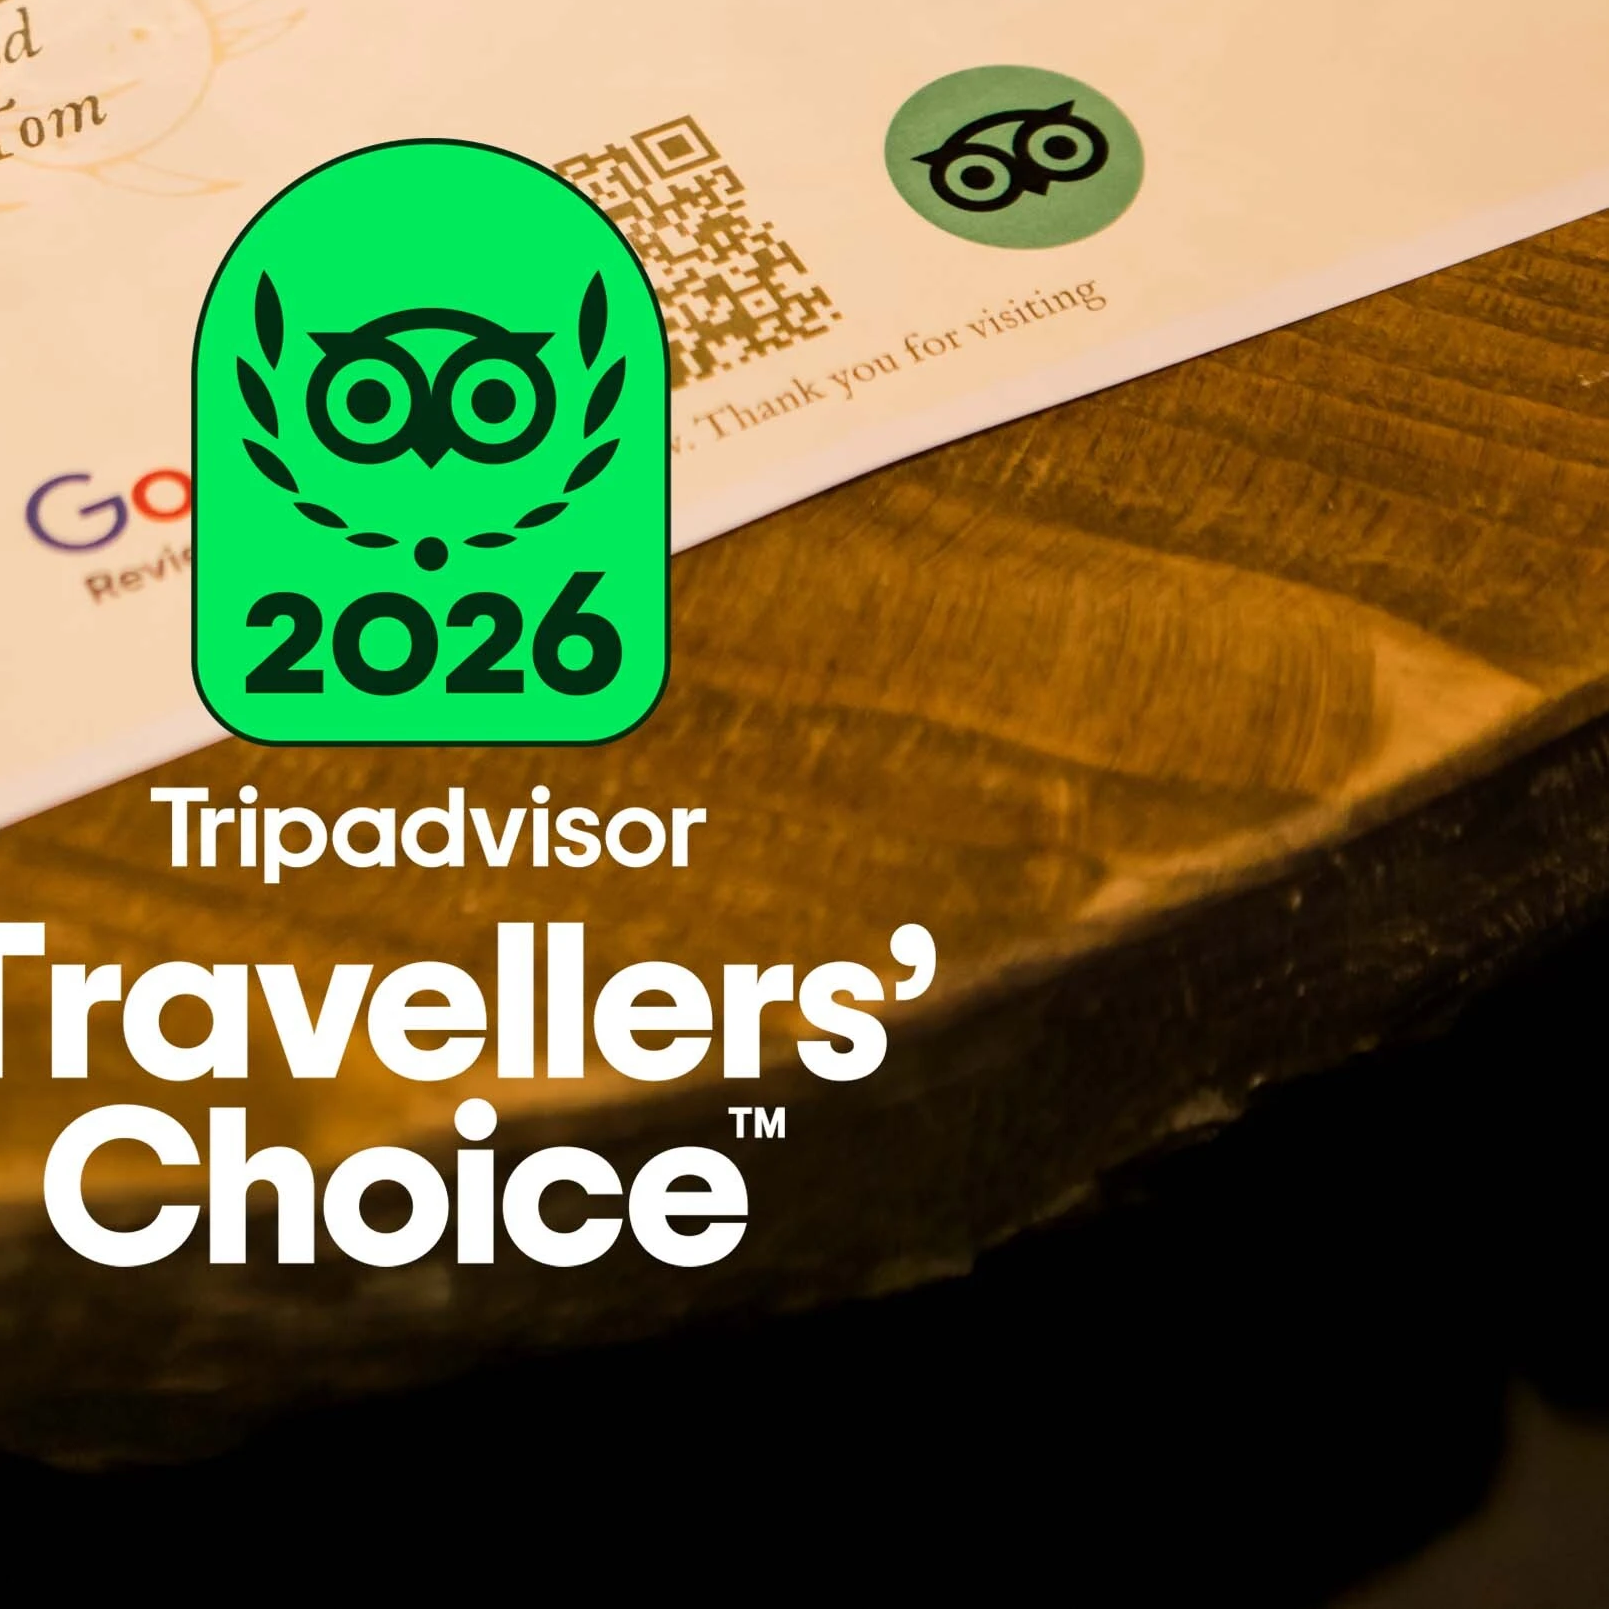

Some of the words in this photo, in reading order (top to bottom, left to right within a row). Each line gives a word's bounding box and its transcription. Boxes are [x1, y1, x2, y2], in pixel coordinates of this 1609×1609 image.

[693, 377, 826, 441] Thank
[828, 351, 901, 400] you
[903, 332, 963, 365] for
[963, 279, 1108, 341] visiting
[25, 467, 191, 554] Go
[83, 543, 191, 606] Revi
